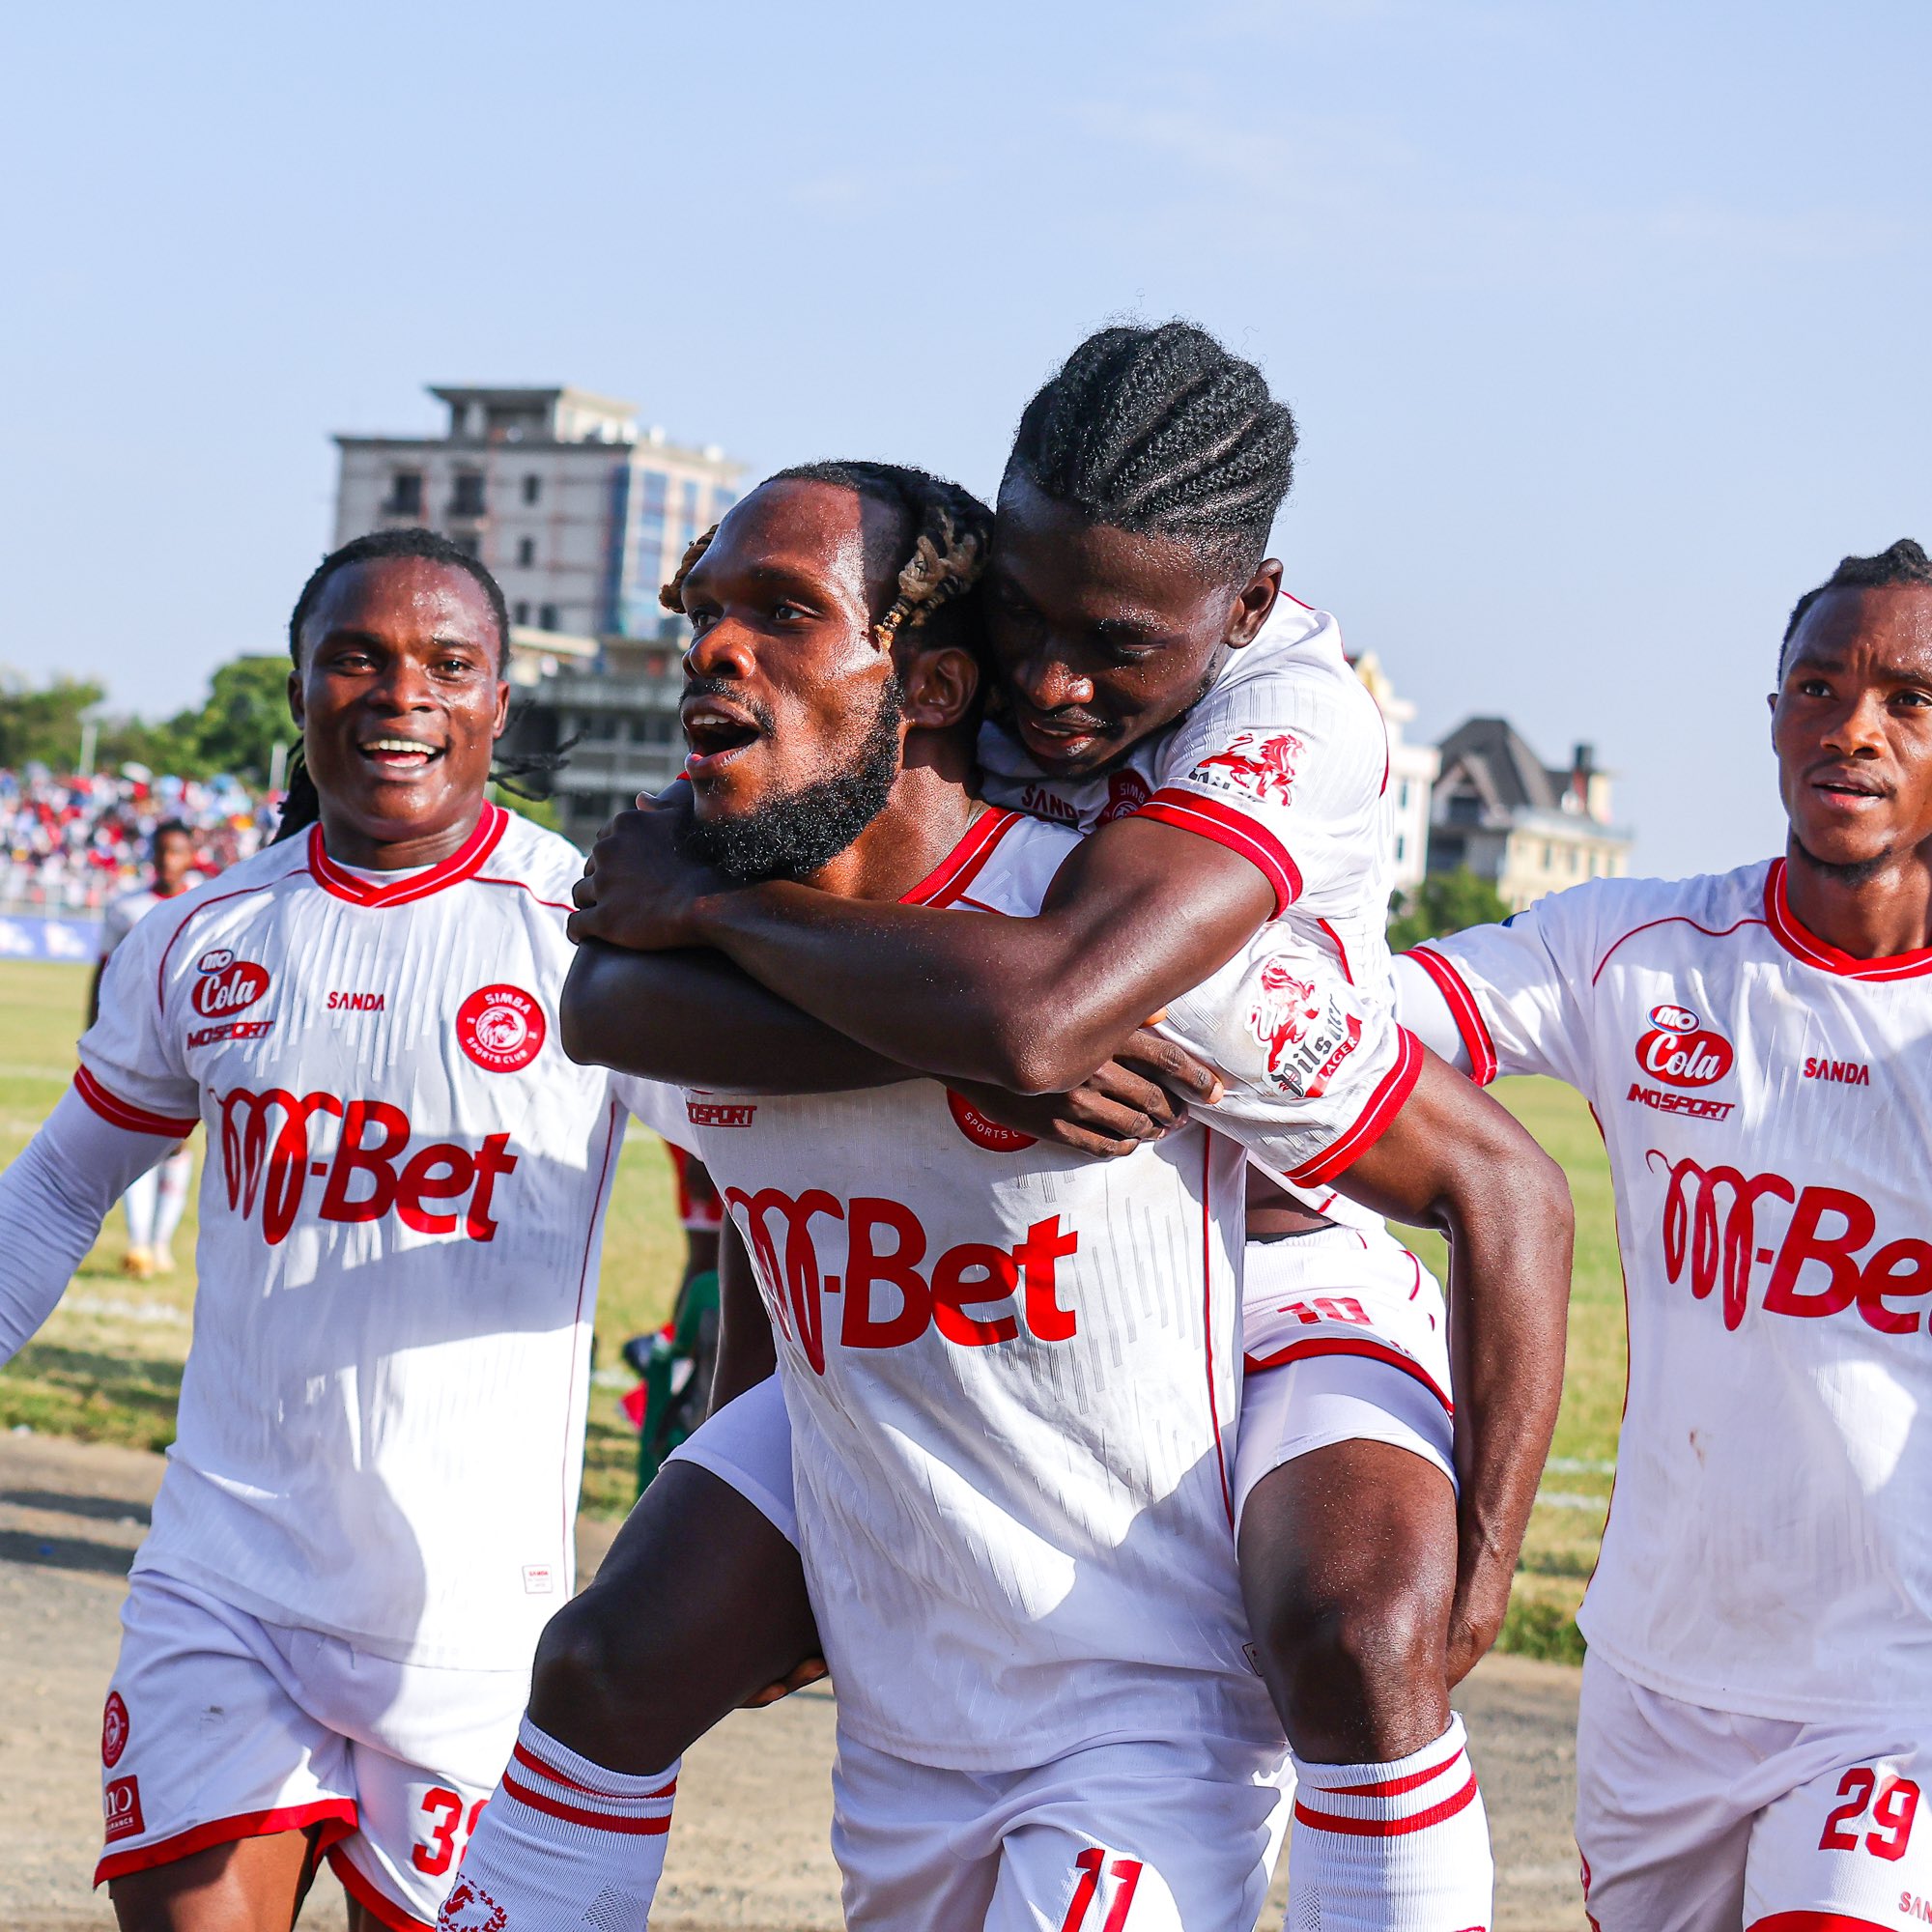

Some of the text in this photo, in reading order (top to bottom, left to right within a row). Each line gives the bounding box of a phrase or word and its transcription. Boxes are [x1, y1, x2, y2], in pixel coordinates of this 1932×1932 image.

[1021, 783, 1093, 819] SAND
[1120, 782, 1146, 804] SIMB
[201, 970, 256, 1014] Cola
[327, 991, 384, 1011] SANDA
[484, 992, 531, 1015] SIMBA
[187, 1021, 274, 1051] MOSPORT
[467, 1037, 501, 1065] SPORTS
[1318, 1037, 1358, 1082] LAGER
[1646, 1032, 1721, 1081] Cola
[1804, 1057, 1870, 1087] SANDA
[687, 1102, 758, 1128] OSPORT
[1626, 1083, 1736, 1122] MOSPORT
[964, 1112, 1009, 1139] SPORTS
[1645, 1150, 1932, 1332] M-Be
[1818, 1767, 1921, 1862] 29
[1061, 1847, 1144, 1932] 11
